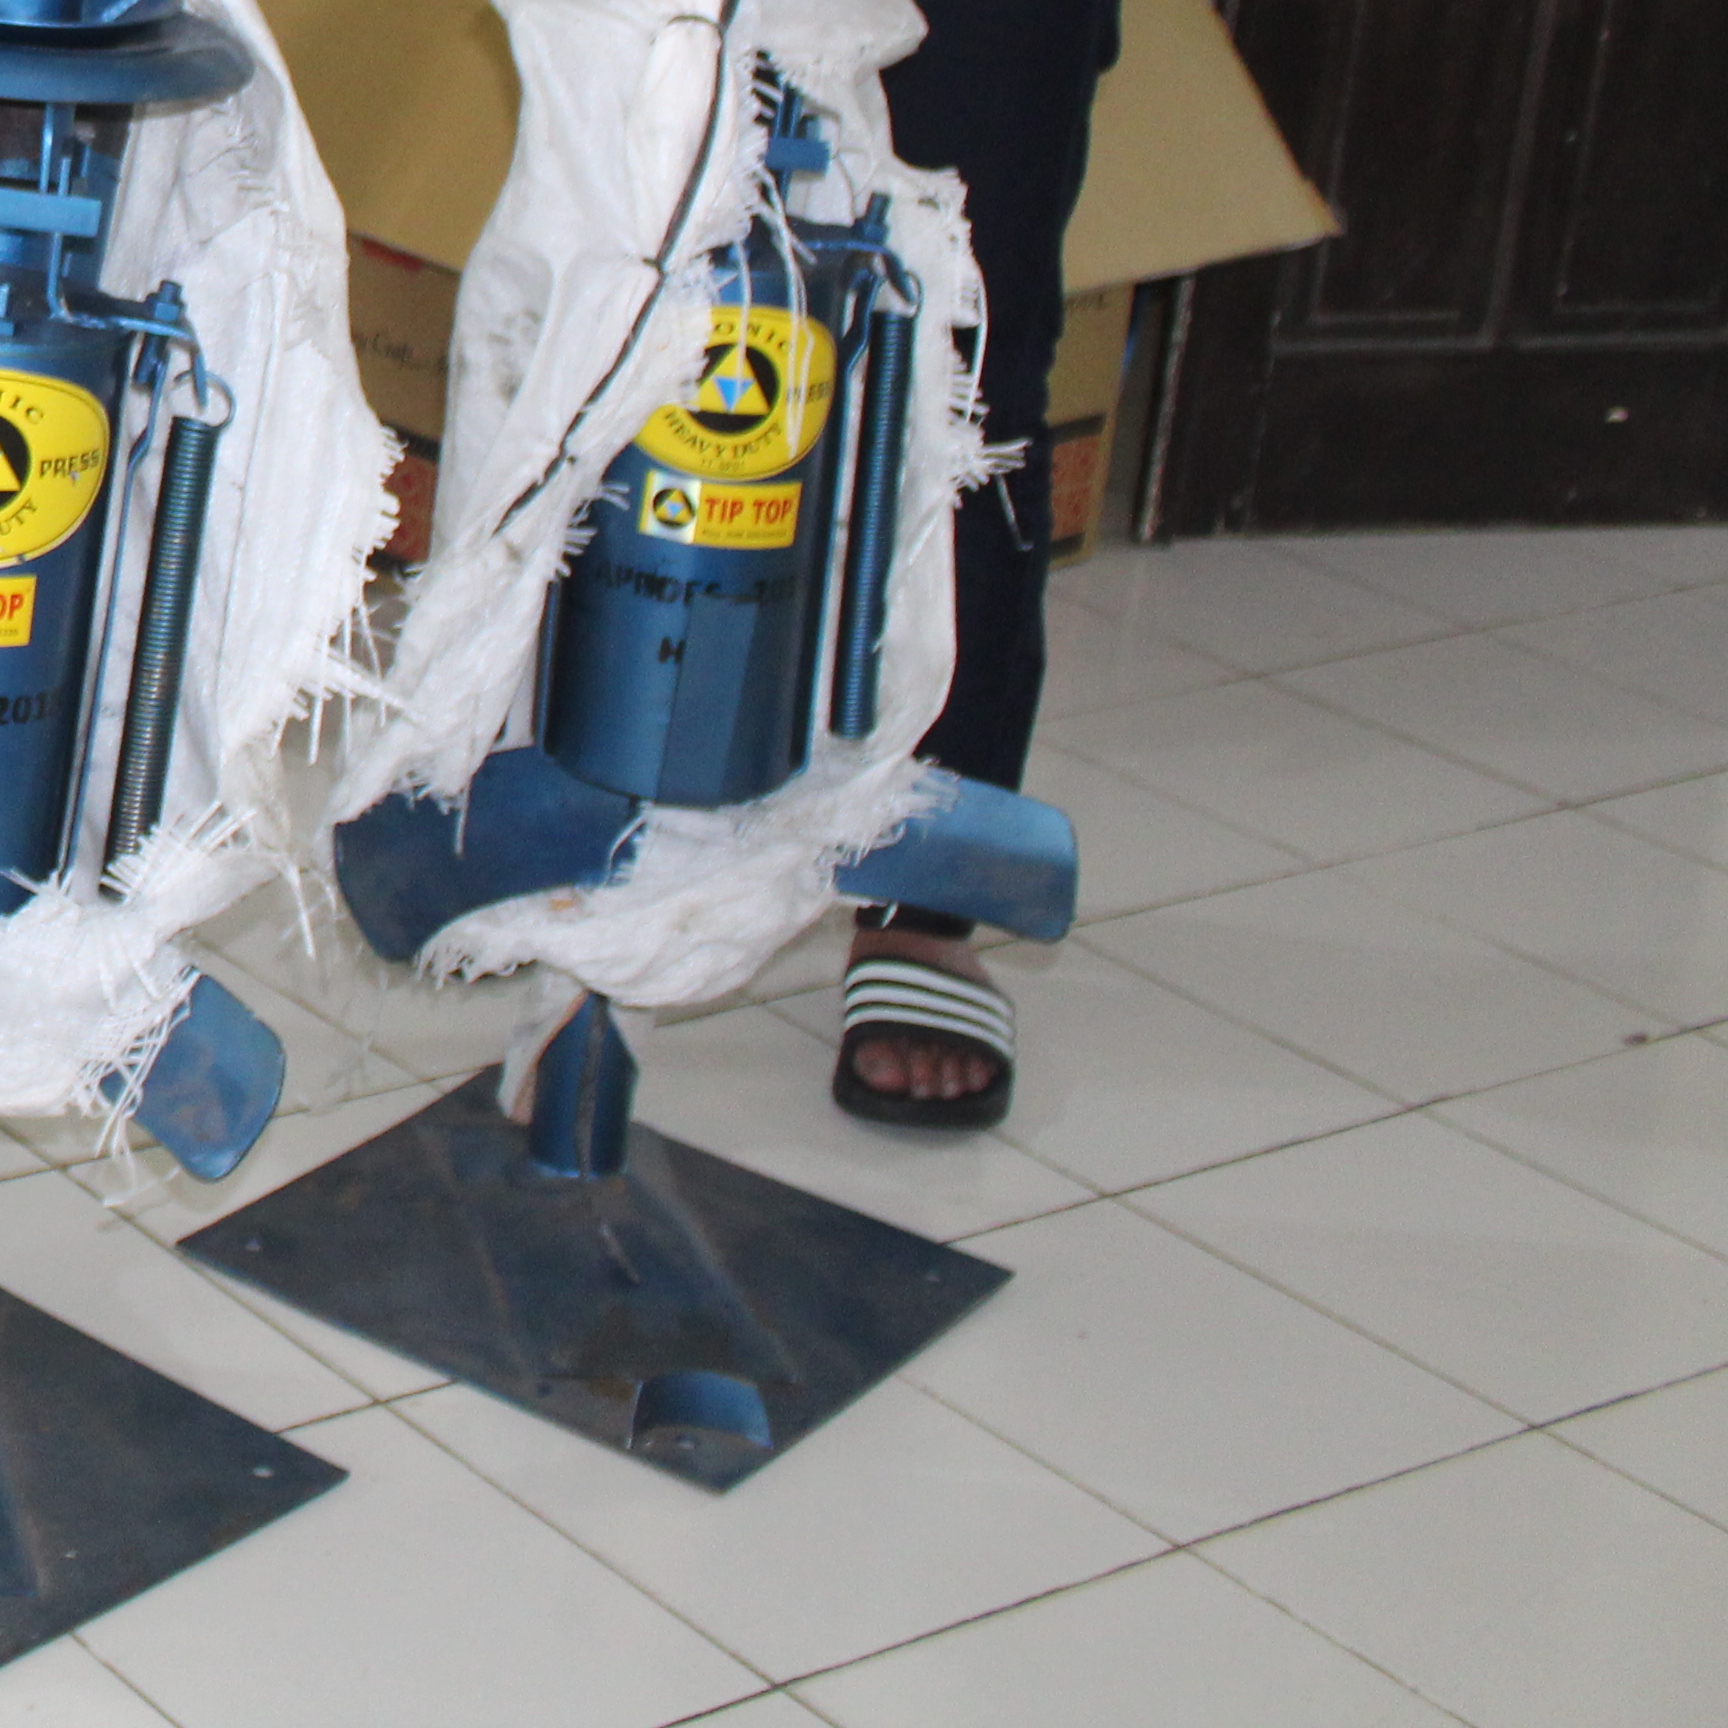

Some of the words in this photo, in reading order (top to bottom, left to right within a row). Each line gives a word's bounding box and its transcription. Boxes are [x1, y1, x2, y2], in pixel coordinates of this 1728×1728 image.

[39, 448, 100, 480] PRESS
[705, 497, 743, 524] TIP
[753, 499, 793, 525] TOP
